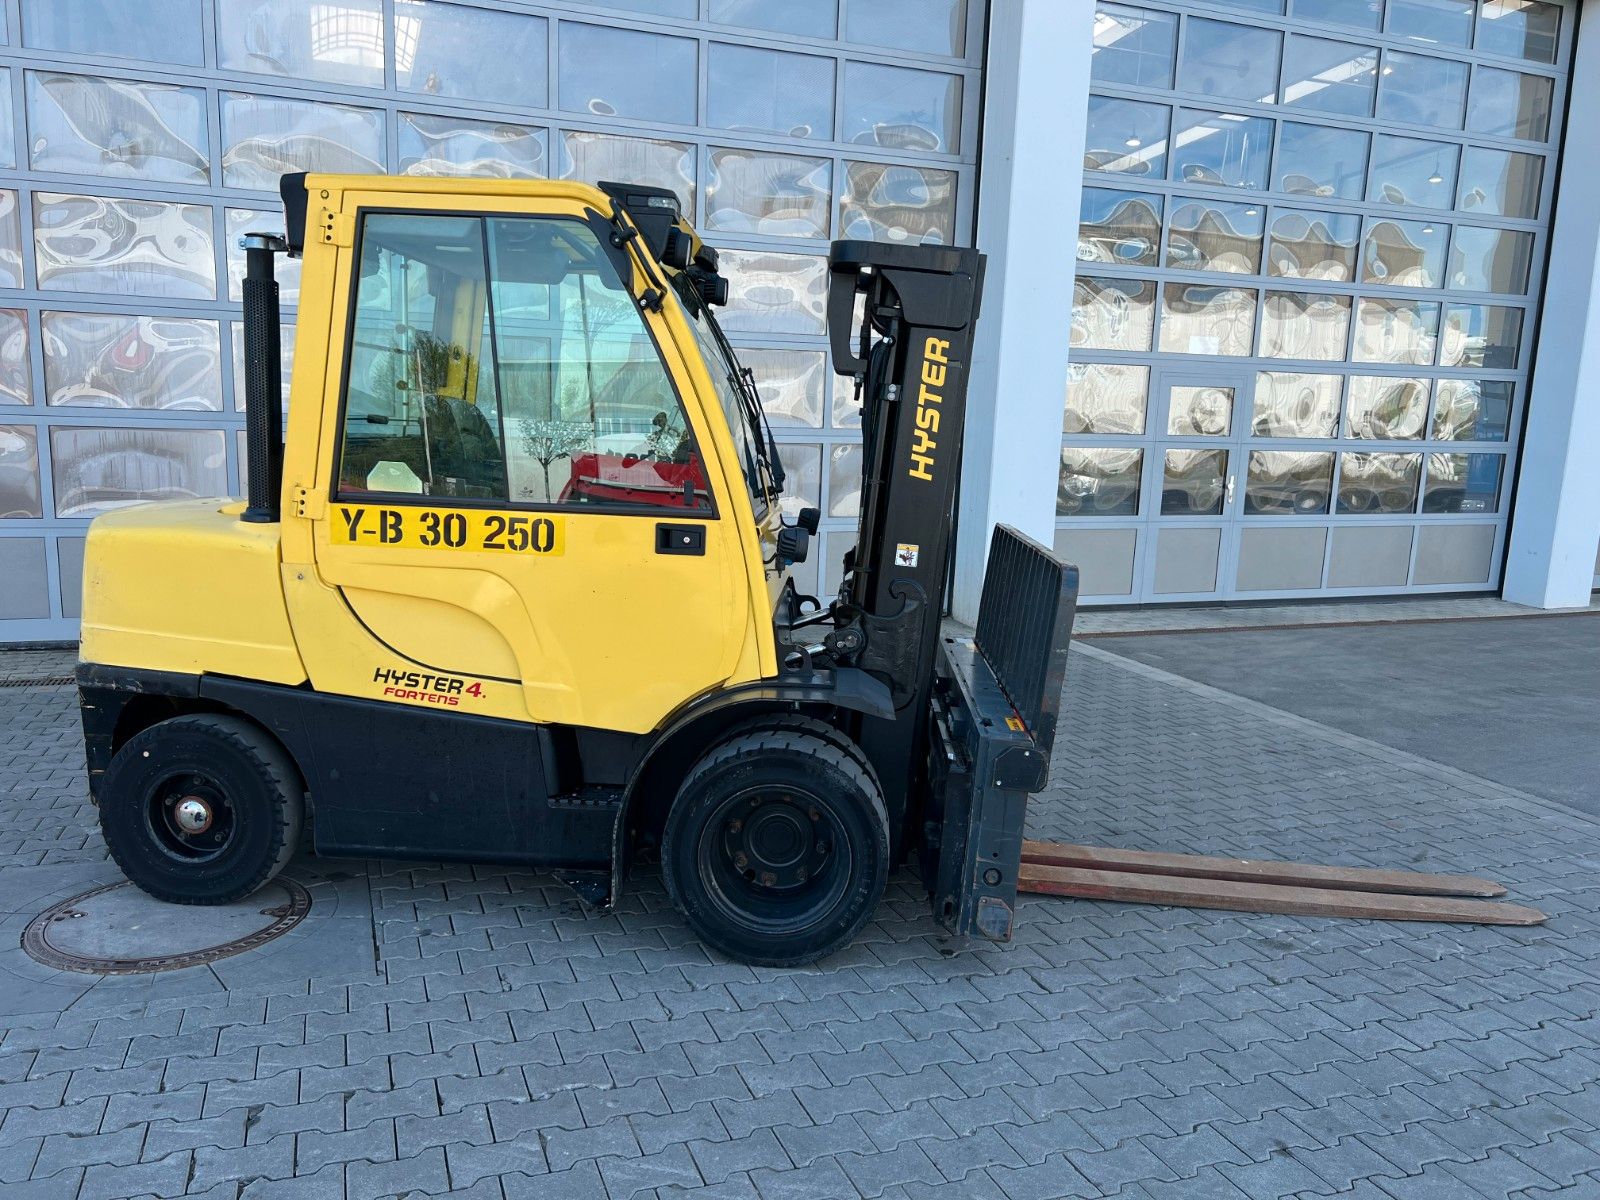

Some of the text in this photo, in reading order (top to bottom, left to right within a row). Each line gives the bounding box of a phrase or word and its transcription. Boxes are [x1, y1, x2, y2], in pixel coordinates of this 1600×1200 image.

[908, 336, 950, 481] HYSTER
[340, 508, 555, 553] Y-B 30 250
[373, 667, 464, 695] HYSTER
[383, 687, 460, 706] FORTENS
